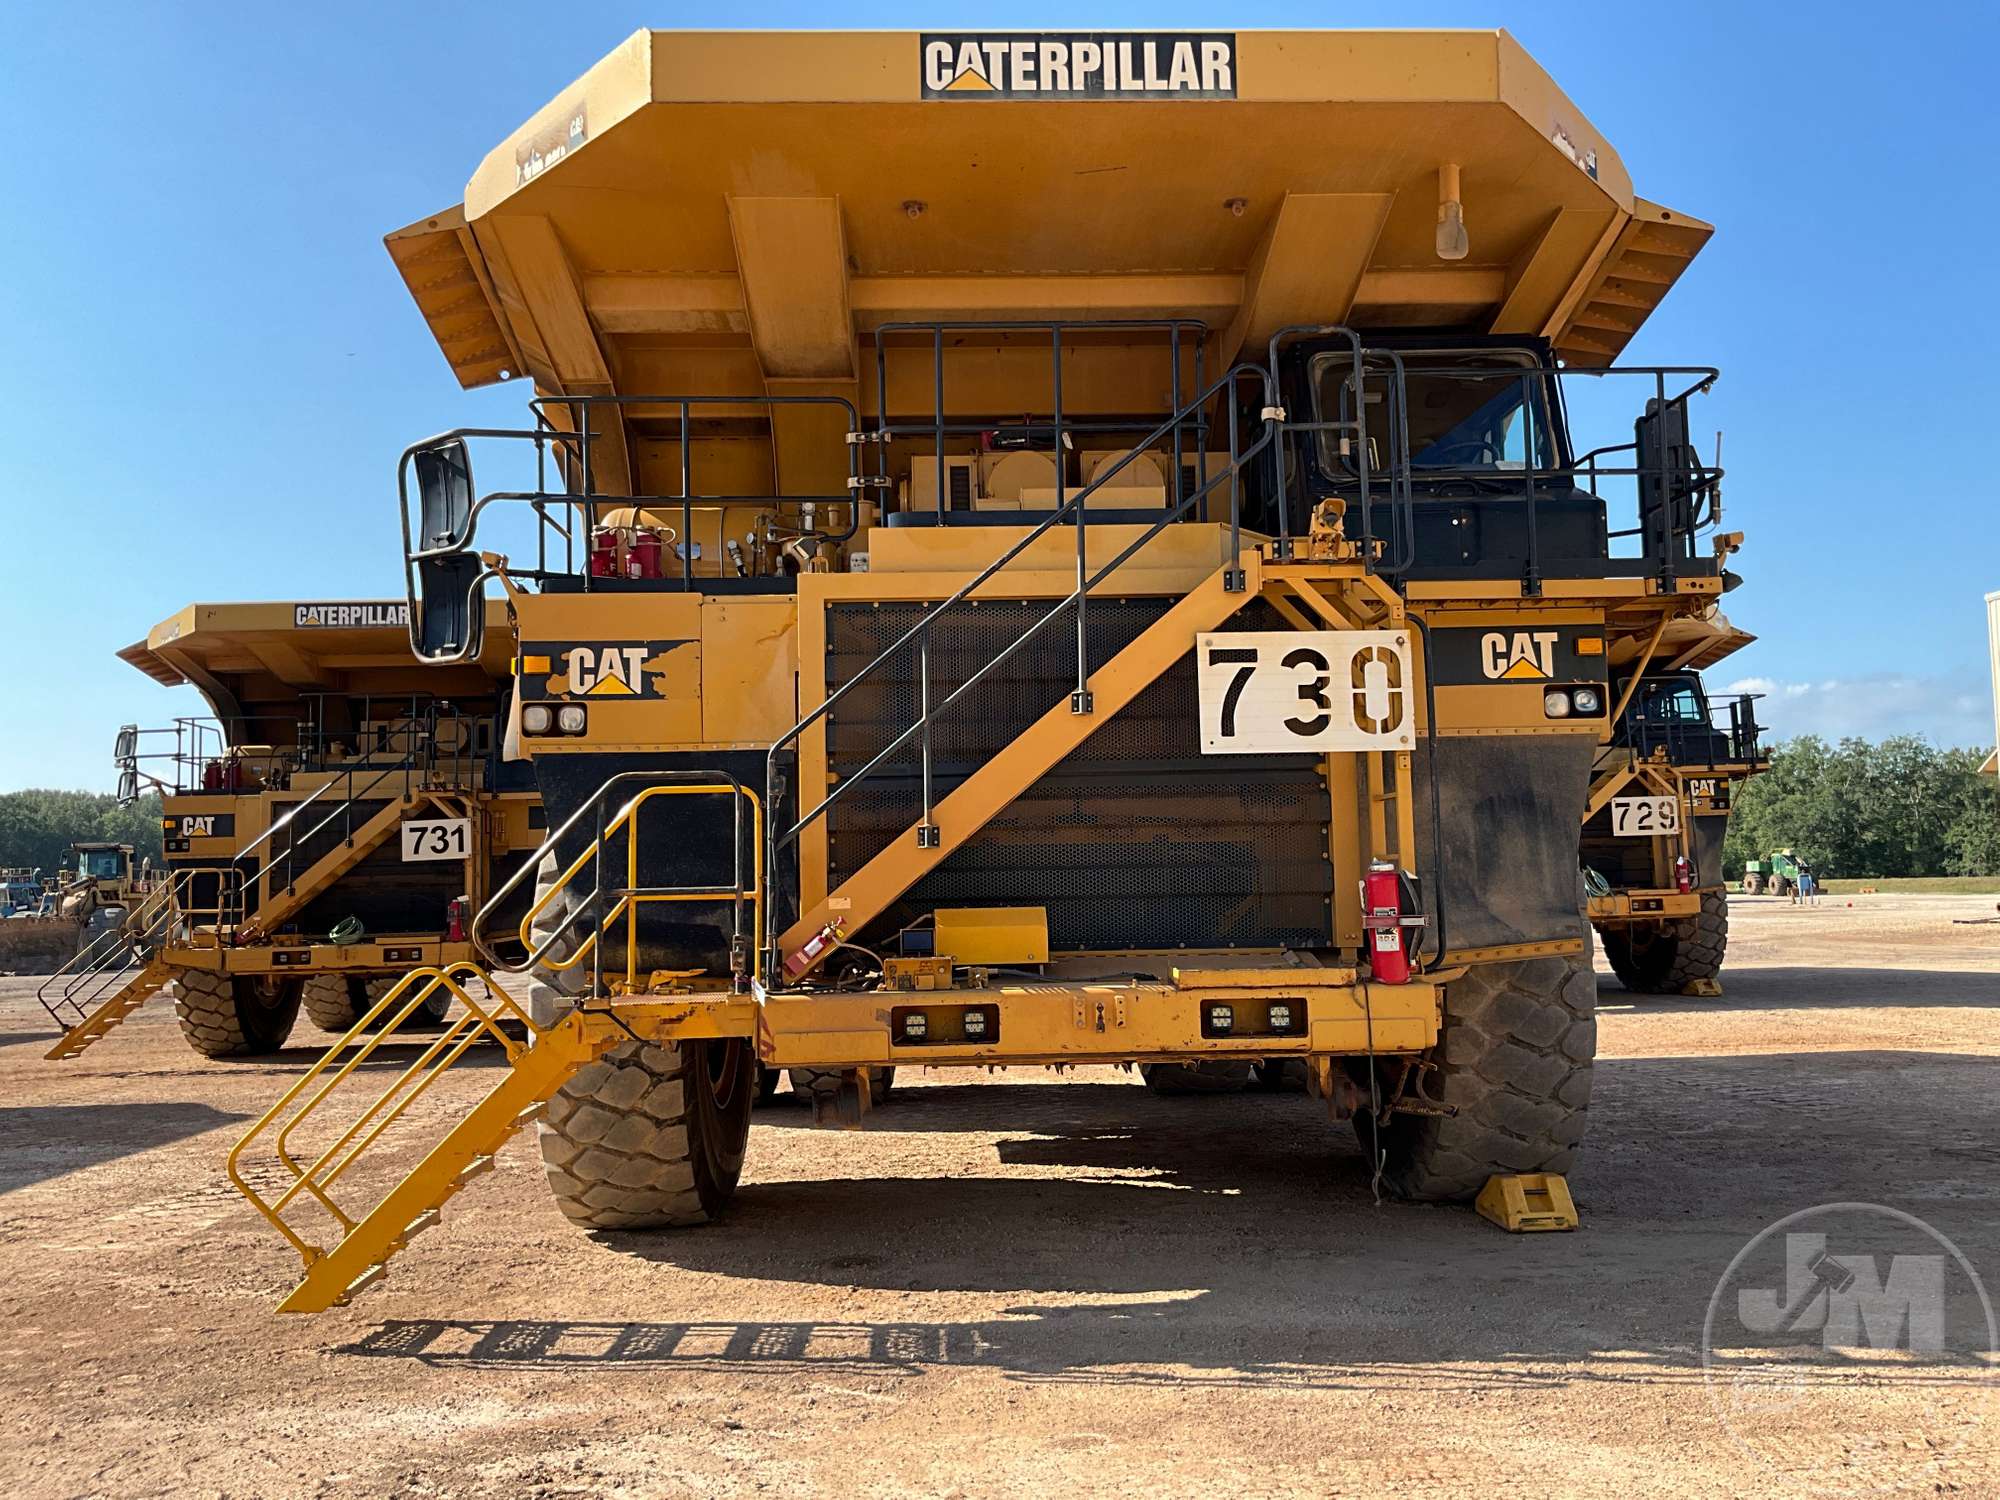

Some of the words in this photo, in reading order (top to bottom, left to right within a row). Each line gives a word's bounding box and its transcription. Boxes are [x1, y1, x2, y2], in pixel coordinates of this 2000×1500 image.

[925, 41, 1232, 91] CATERPILLAR
[296, 605, 408, 626] CATERPILLAR
[568, 647, 649, 695] CAT
[1482, 632, 1558, 679] CAT
[1208, 646, 1403, 737] 730
[1690, 779, 1716, 796] CAT
[182, 816, 215, 837] CAT
[1615, 801, 1675, 831] 729
[409, 824, 466, 855] 731
